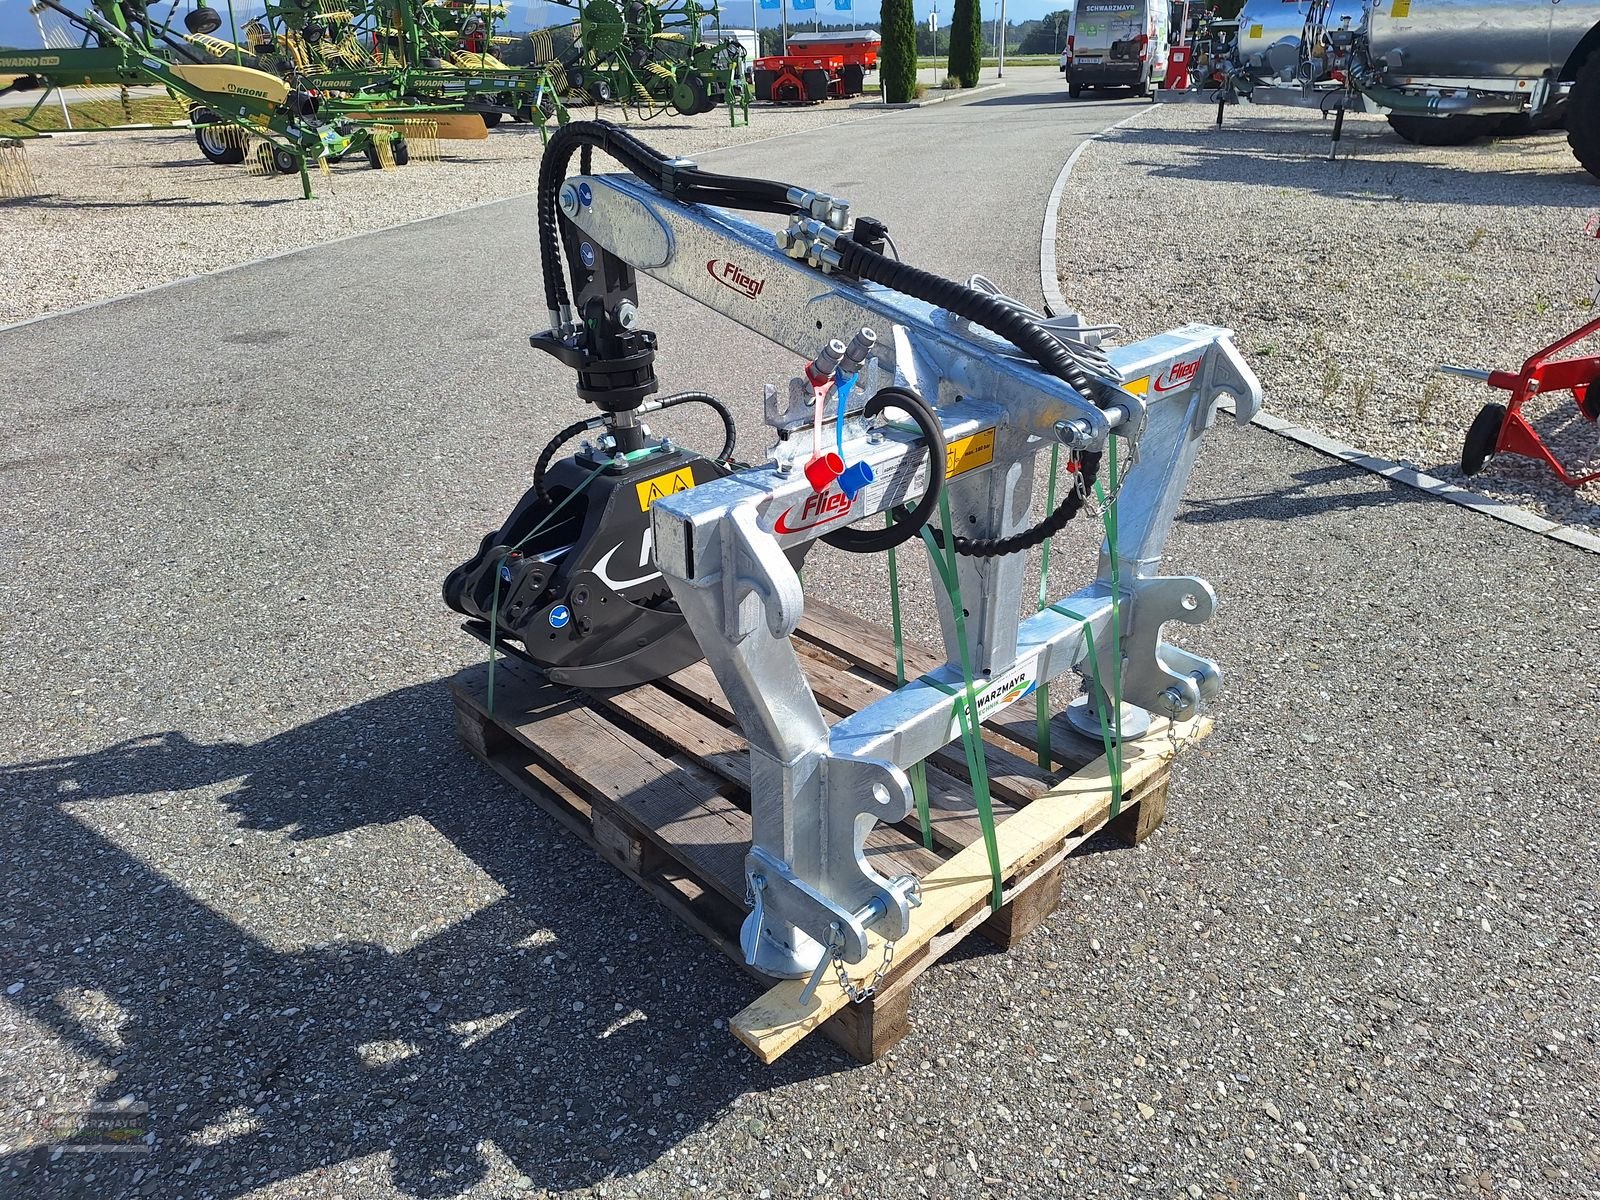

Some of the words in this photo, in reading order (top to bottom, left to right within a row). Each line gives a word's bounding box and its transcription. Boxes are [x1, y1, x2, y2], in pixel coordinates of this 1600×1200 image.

[1086, 4, 1135, 12] SCHWARZMAYR
[0, 57, 39, 67] WADRO
[236, 87, 269, 98] KRONE
[723, 262, 766, 297] Fliegl
[1168, 354, 1203, 382] Fliegl
